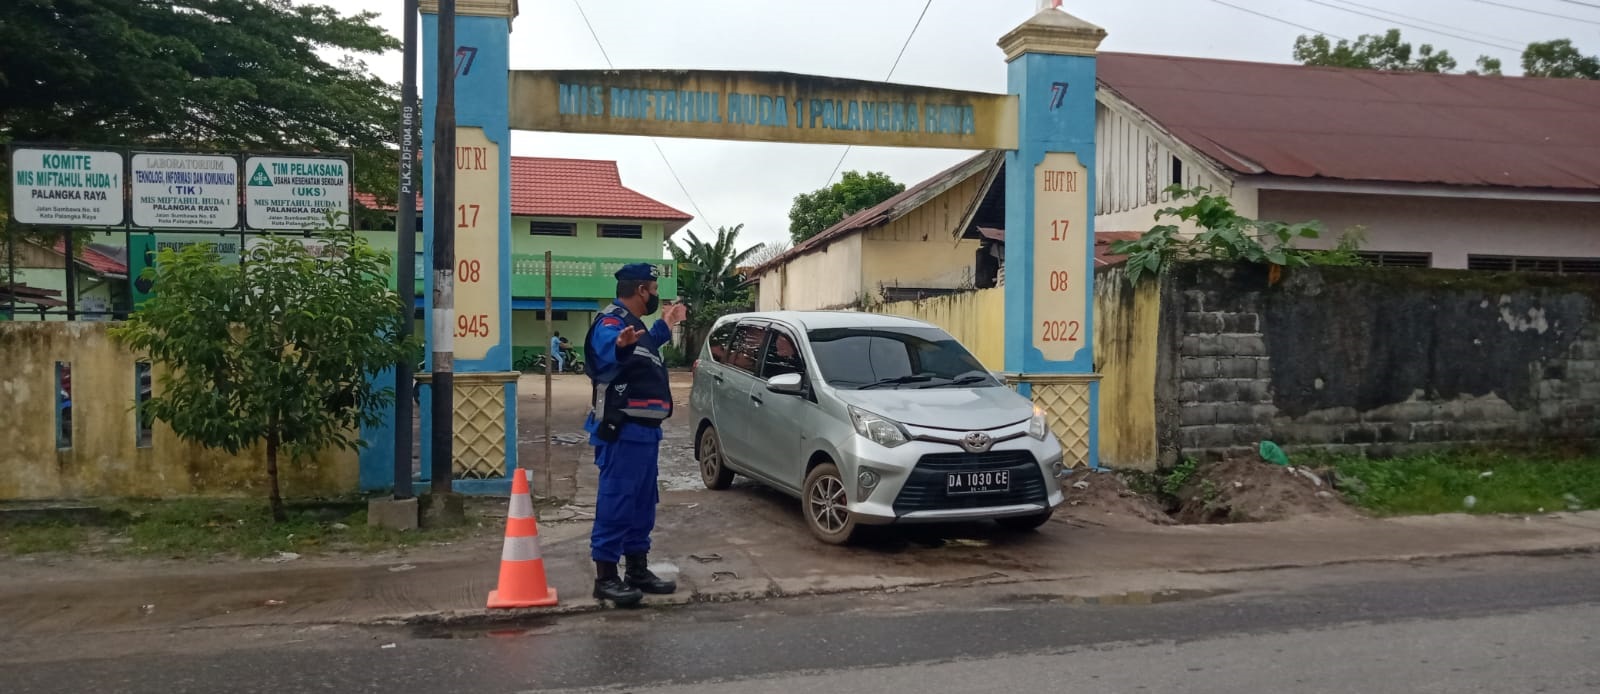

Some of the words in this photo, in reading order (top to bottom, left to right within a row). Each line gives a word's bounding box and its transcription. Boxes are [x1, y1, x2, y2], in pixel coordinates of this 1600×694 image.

[559, 83, 604, 117] MIS
[610, 86, 722, 123] MIFTAHUL
[728, 92, 788, 128] HUDA
[794, 96, 803, 128] 1
[925, 103, 975, 134] RAYA
[42, 154, 91, 170] KOMITE
[147, 158, 224, 170] LABORATORIUM
[272, 162, 288, 175] TIM
[290, 163, 344, 177] PELAKSANA
[16, 170, 34, 186] MIS
[36, 171, 83, 187] MIFTAHUL
[85, 173, 111, 189] HUDA
[113, 174, 118, 189] 1
[166, 171, 193, 185] INFORMASI
[193, 172, 203, 185] DAN
[204, 172, 235, 185] KOMUNIKASI
[273, 177, 291, 185] USAHA
[292, 177, 320, 185] KESEHATAN
[321, 177, 344, 186] SEKOLAH
[31, 189, 82, 200] PALANGKA
[84, 190, 107, 201] RAYA
[140, 196, 156, 204] MIS
[157, 196, 200, 205] MIFTAHUL
[202, 197, 225, 205] HUDA
[153, 204, 196, 212] PALANGKA
[270, 199, 312, 207] MIFTAHUL
[314, 200, 336, 208] HUDA
[55, 213, 81, 221] Palangka
[457, 204, 480, 228] 17
[1051, 219, 1069, 241] 17
[458, 259, 480, 283] 08
[1050, 270, 1068, 292] 08
[453, 314, 489, 338] 945
[1042, 320, 1079, 341] 2022
[949, 474, 962, 487] DA
[967, 472, 992, 486] 1030
[995, 471, 1007, 485] CE
